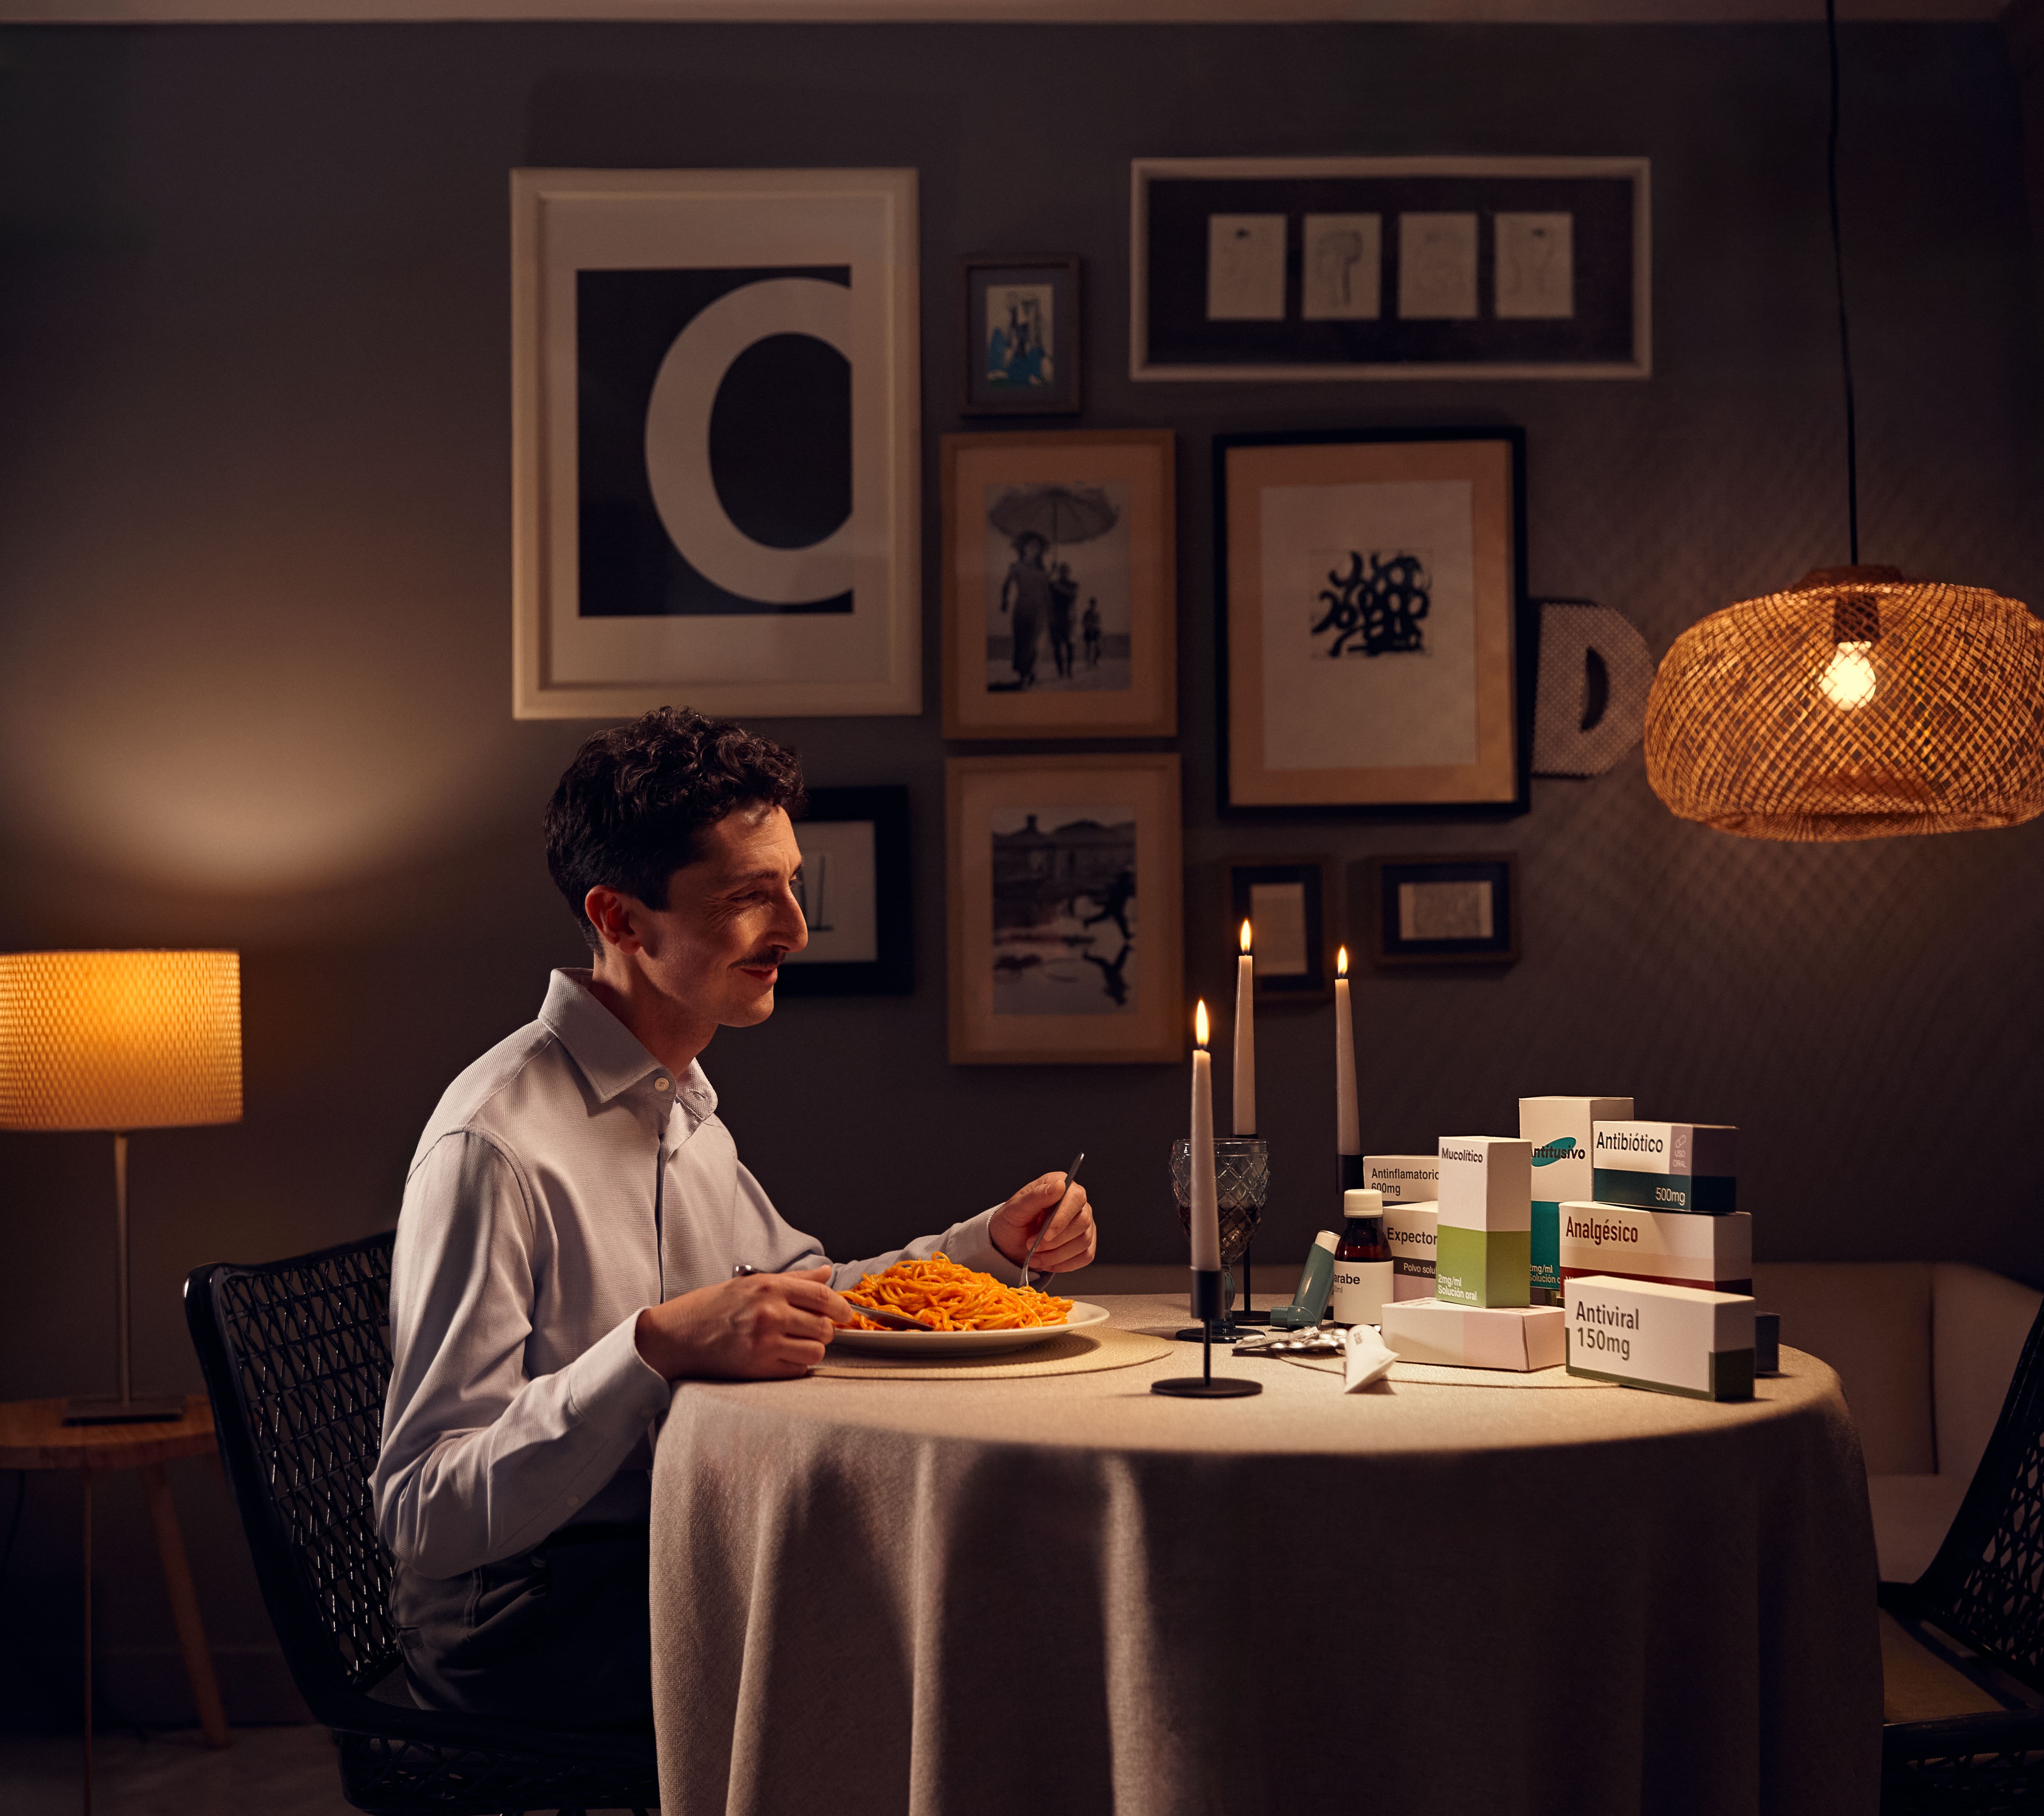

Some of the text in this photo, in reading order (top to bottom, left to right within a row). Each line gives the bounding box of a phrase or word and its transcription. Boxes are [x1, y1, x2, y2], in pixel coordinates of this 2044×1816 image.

[1531, 599, 1655, 779] D
[1597, 1132, 1663, 1153] Antibiótico
[1442, 1148, 1483, 1163] Mucolítico
[1532, 1144, 1585, 1160] ntitusivo
[1673, 1159, 1687, 1168] ORAL
[1371, 1183, 1400, 1196] 600mg
[1656, 1187, 1685, 1206] 500mg
[1566, 1216, 1638, 1245] Analgésico
[1404, 1263, 1436, 1274] Polvo solu
[1334, 1271, 1360, 1285] arabe
[1438, 1274, 1462, 1287] 2mg/ml
[1438, 1285, 1477, 1301] Solución oral
[1576, 1301, 1639, 1330] Antiviral
[1577, 1327, 1630, 1361] 150mg
